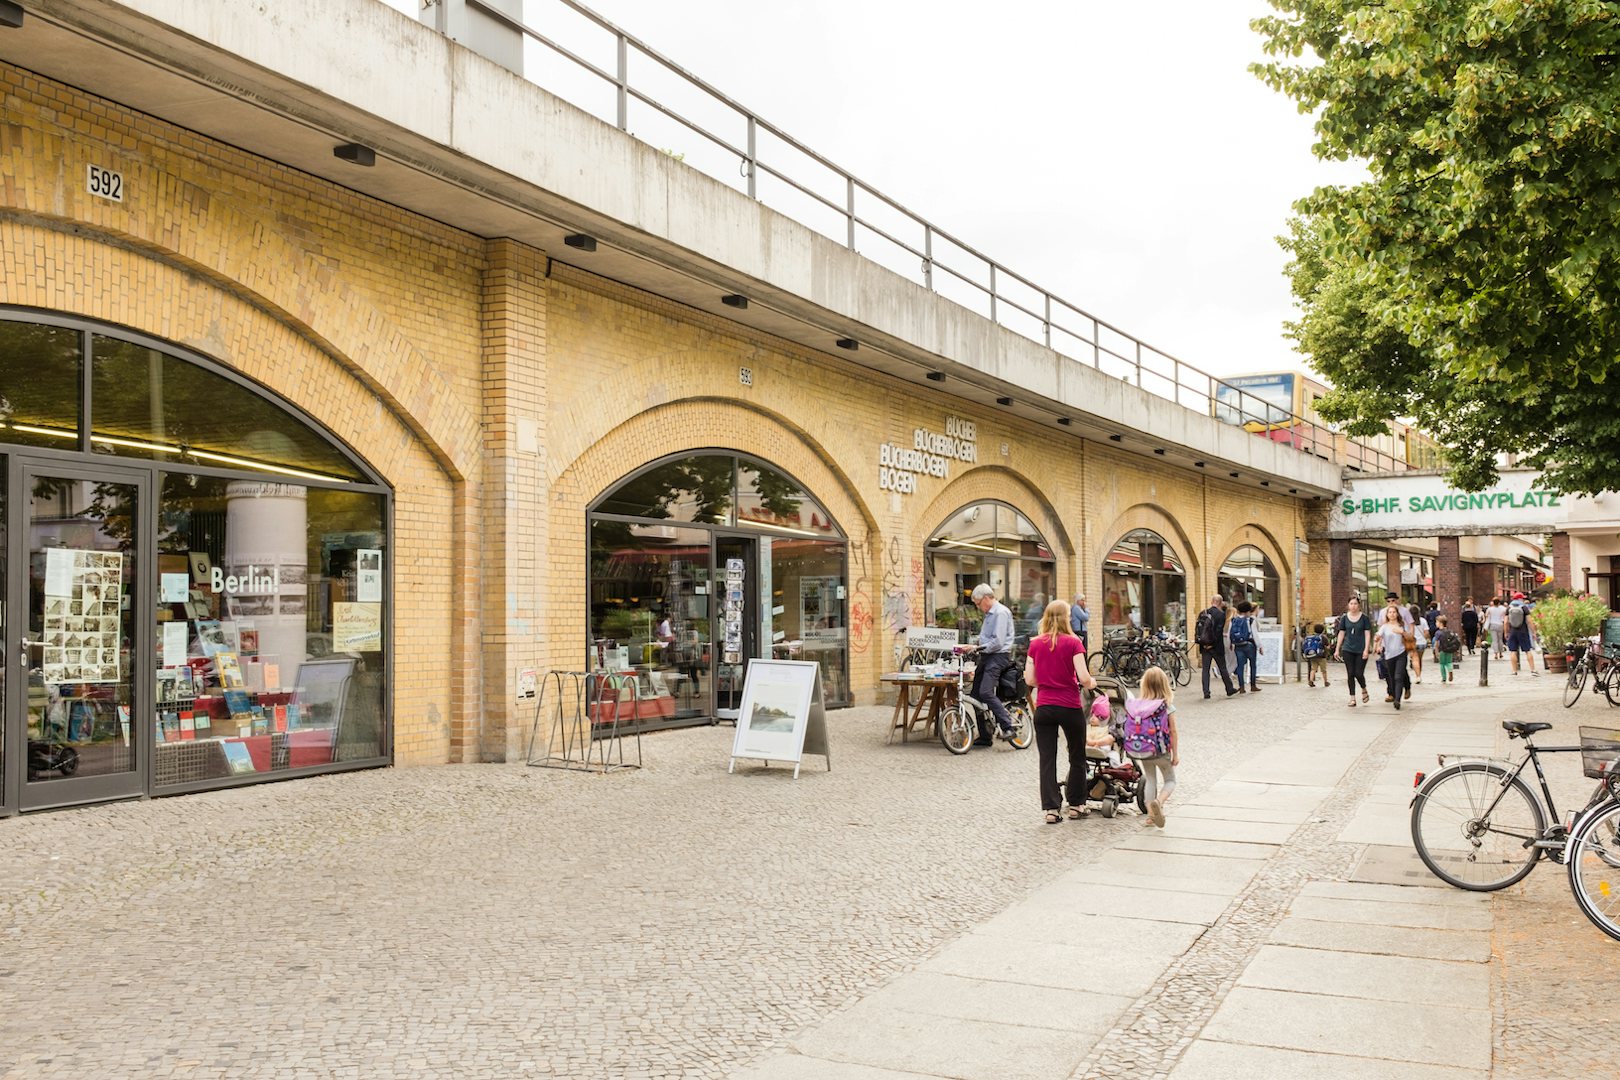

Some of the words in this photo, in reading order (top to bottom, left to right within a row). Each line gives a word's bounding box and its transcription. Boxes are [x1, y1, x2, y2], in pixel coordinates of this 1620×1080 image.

[91, 166, 121, 199] 592
[946, 415, 977, 441] BÜCHER
[880, 442, 949, 478] BÜCHERBOGEN
[914, 428, 977, 463] BÜCHERBOGEN
[880, 466, 916, 494] BOGEN
[1409, 491, 1560, 512] SAVIGNYPLATZ
[210, 564, 279, 594] Berlin!
